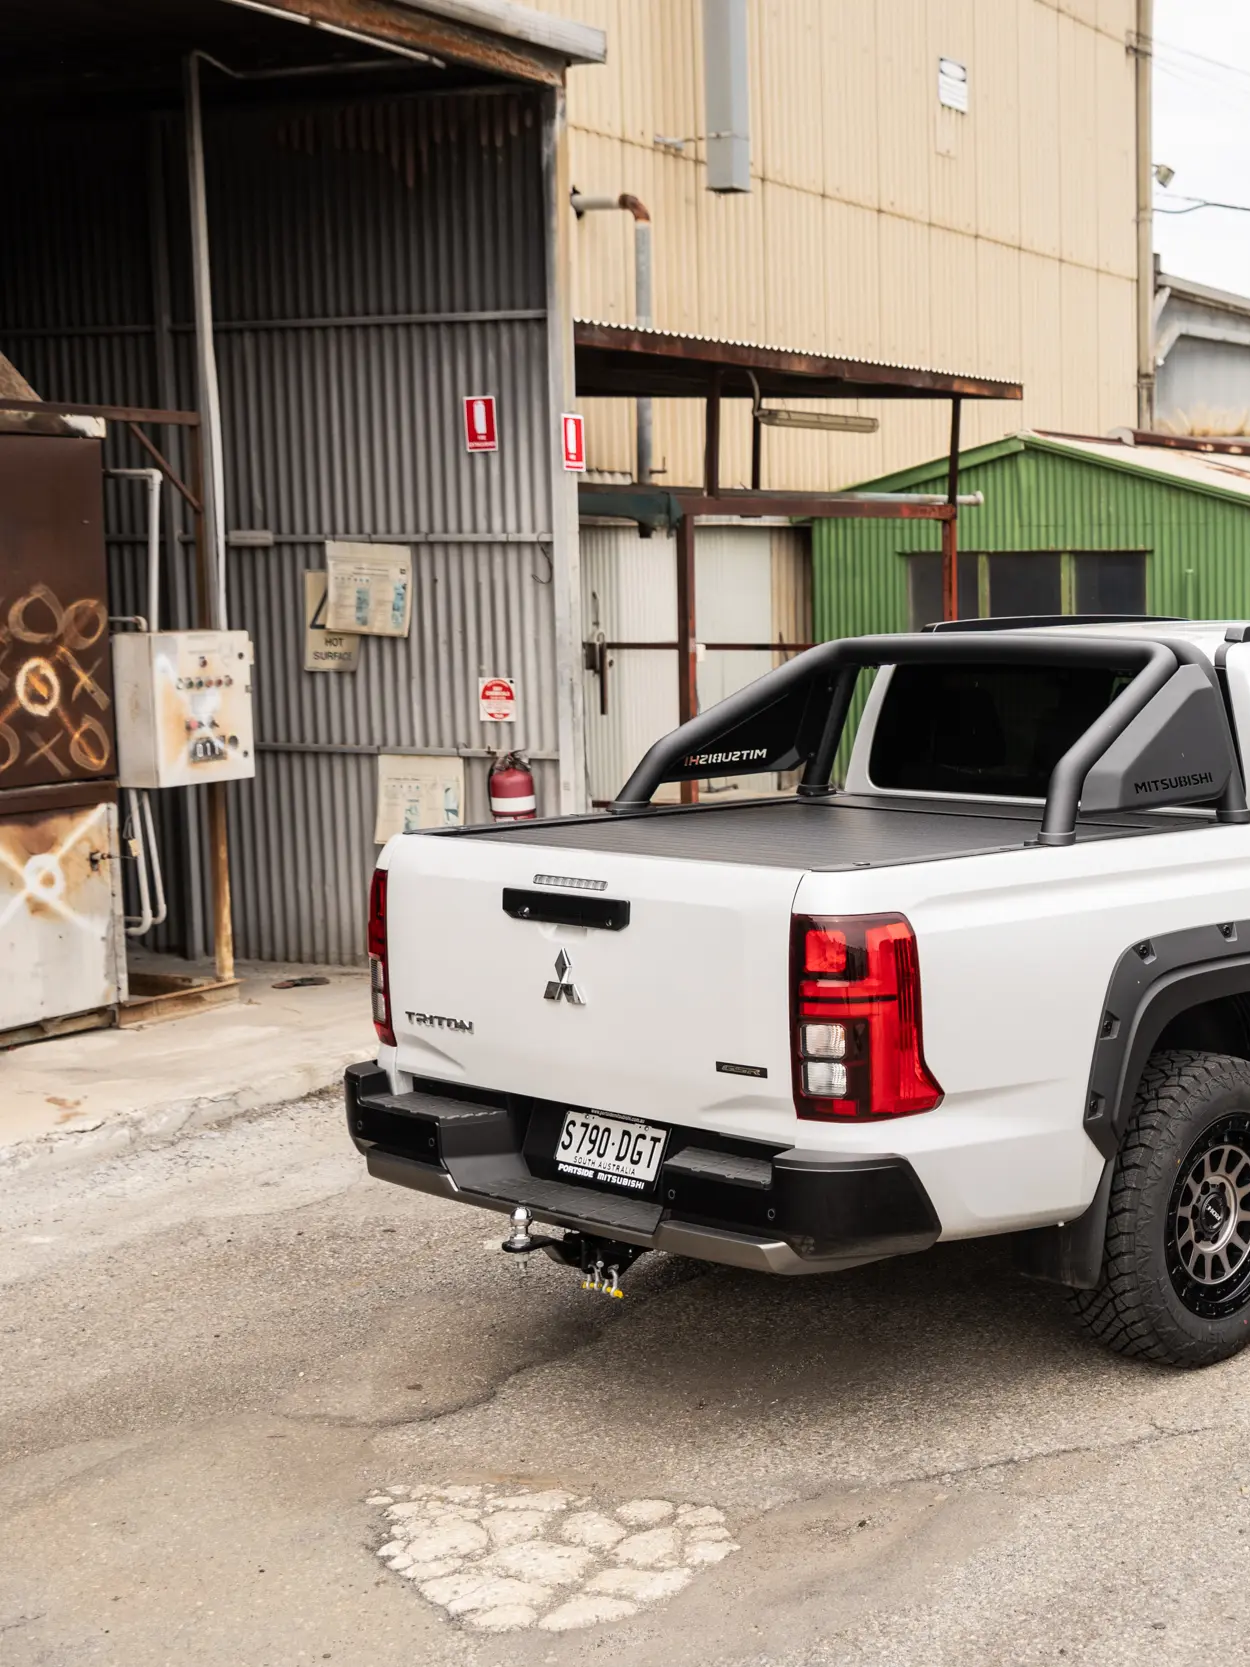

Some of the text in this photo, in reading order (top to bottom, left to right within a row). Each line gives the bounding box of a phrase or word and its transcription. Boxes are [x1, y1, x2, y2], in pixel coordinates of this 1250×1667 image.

[324, 637, 344, 647] HOT
[313, 651, 352, 661] SURFACE
[1134, 771, 1214, 795] MITSUBISHI
[404, 1010, 474, 1035] TRITON
[558, 1163, 645, 1190] PORTSIDE MITSUBISHI
[573, 1155, 636, 1176] SOUTH AUSTRALIA
